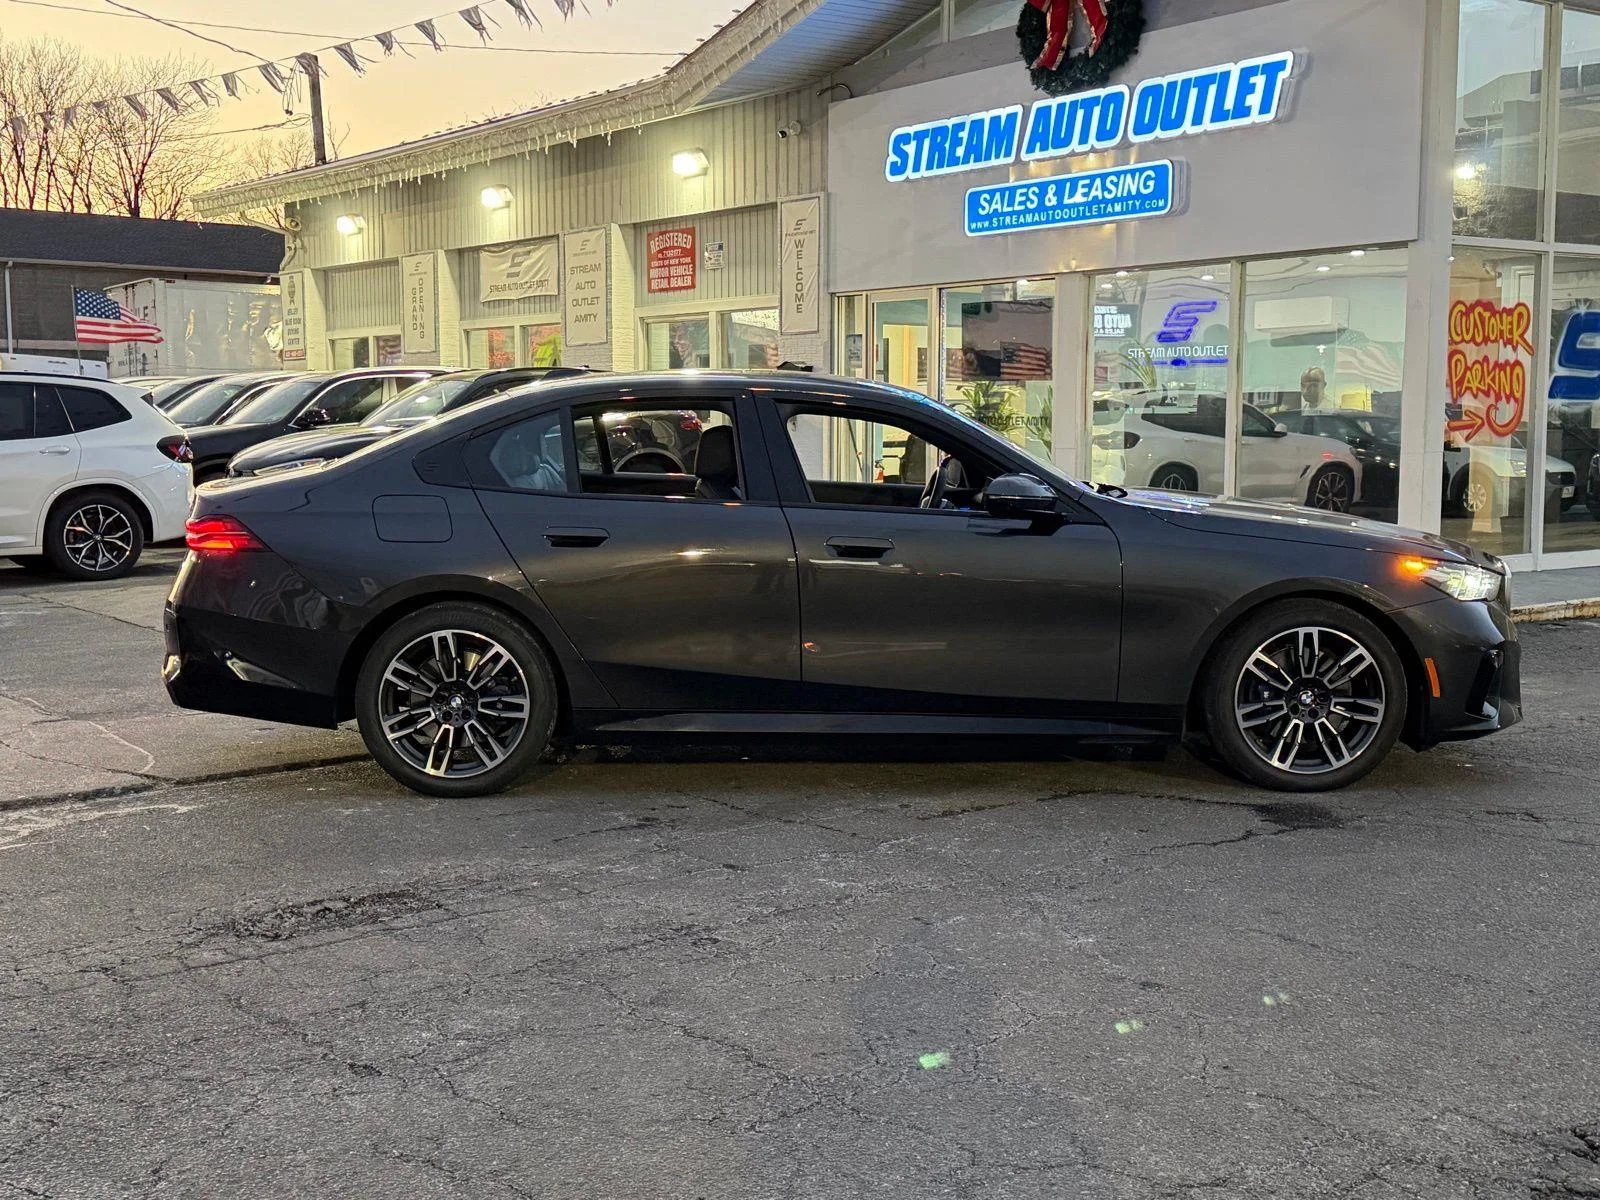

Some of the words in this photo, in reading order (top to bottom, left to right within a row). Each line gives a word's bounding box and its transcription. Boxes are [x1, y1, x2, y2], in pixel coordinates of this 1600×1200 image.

[887, 111, 1020, 178] STREAM
[1024, 88, 1127, 156] AUTO
[1131, 58, 1288, 138] OUTLET
[978, 186, 1039, 215] SALES
[1044, 184, 1058, 207] &
[1063, 169, 1157, 204] LEASING
[650, 232, 692, 254] REGISTERED
[569, 263, 602, 275] STREAM
[670, 264, 693, 277] VEHICLE
[670, 276, 692, 288] DEALER
[793, 238, 806, 314] WELCOME
[575, 280, 596, 291] AUTO
[571, 296, 600, 308] OUTLET
[574, 312, 598, 324] AMITY
[1449, 301, 1535, 356] CUSTOMER
[1166, 346, 1191, 357] AUTO
[1192, 345, 1229, 357] OUTLET
